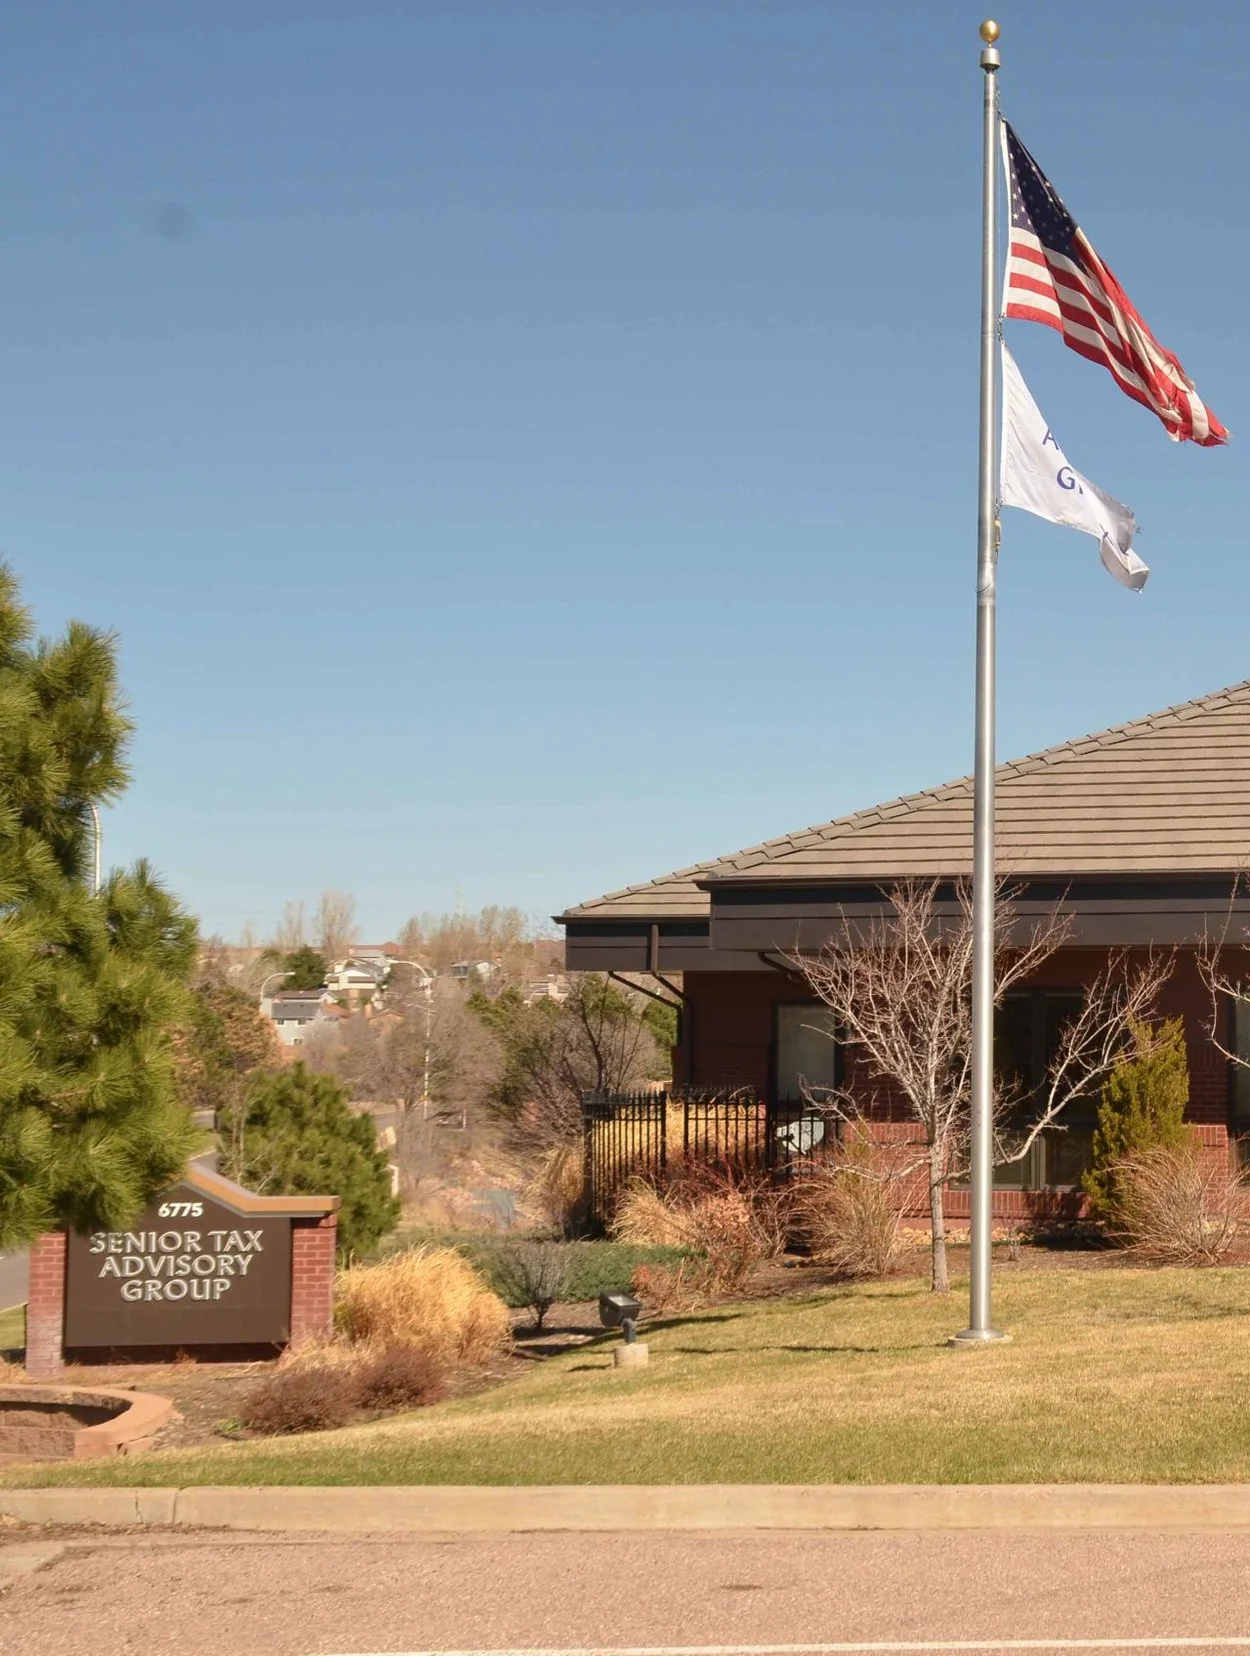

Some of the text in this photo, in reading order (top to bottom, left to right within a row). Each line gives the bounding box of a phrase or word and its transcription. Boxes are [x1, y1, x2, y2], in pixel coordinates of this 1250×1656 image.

[158, 1202, 204, 1218] 6775
[89, 1229, 264, 1254] SENIOR TAX
[98, 1254, 254, 1278] ADVISORY
[120, 1278, 231, 1302] GROUP
